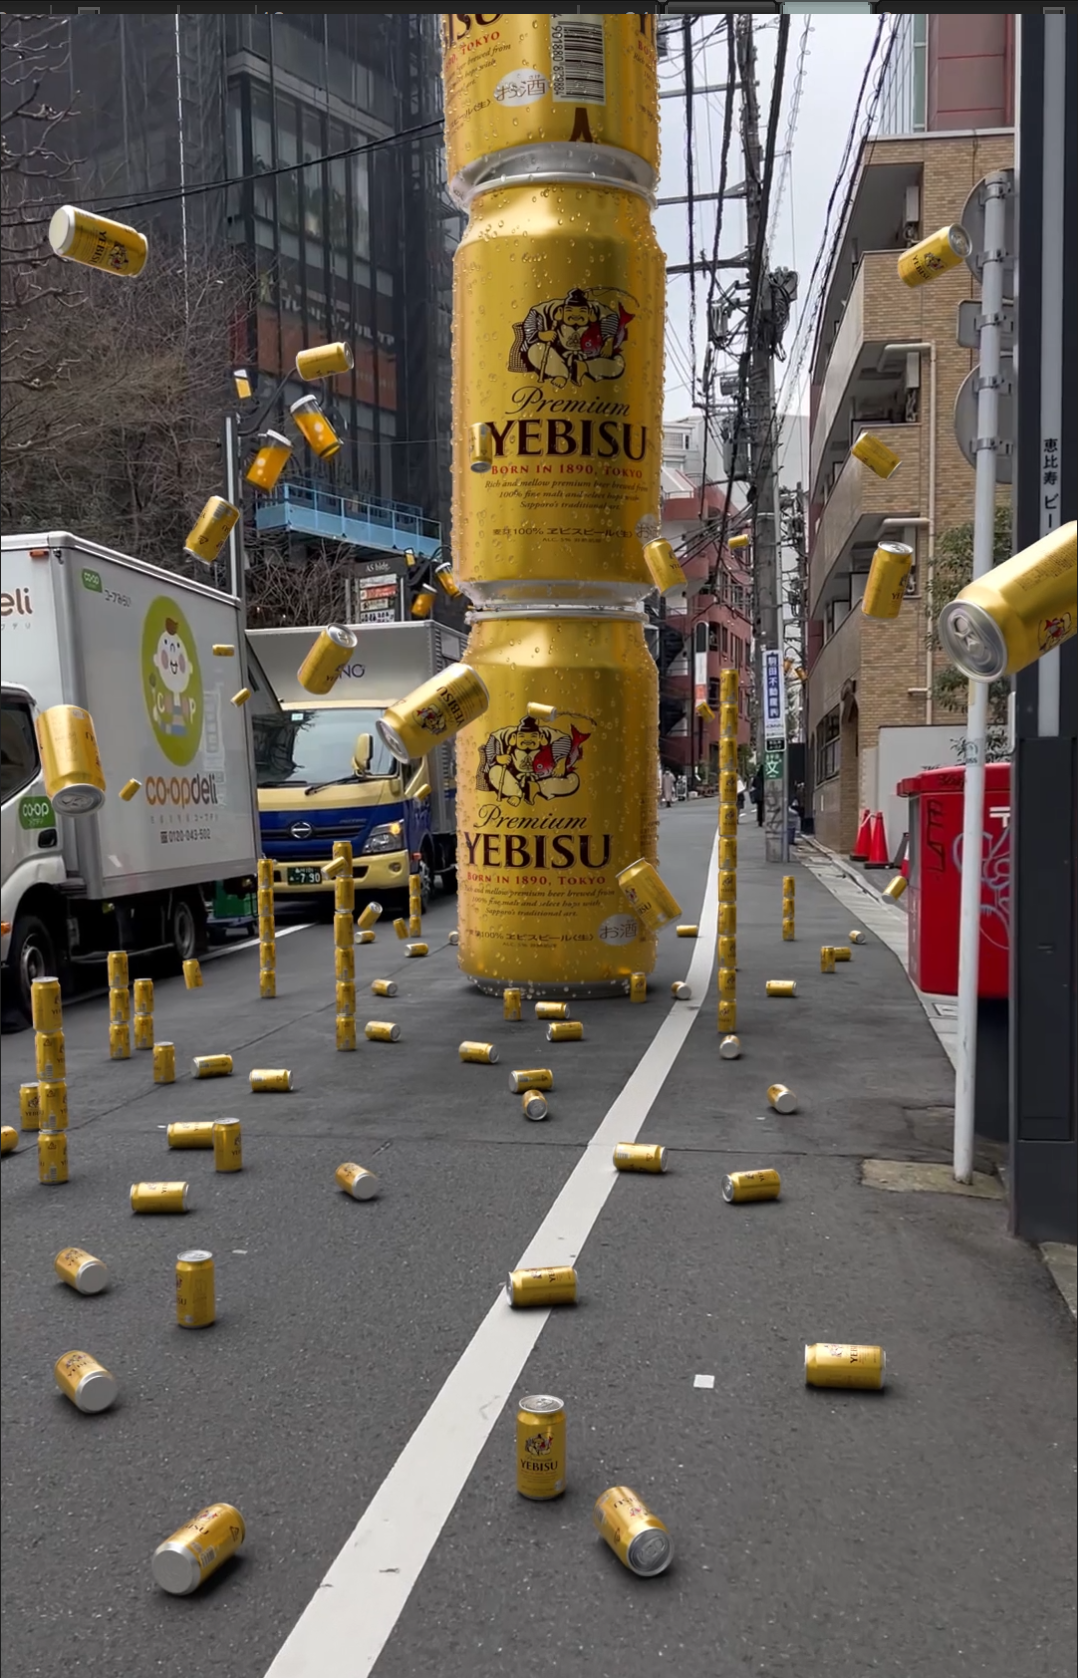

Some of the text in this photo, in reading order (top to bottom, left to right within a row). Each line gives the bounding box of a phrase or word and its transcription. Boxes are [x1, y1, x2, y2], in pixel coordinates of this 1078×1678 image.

[461, 31, 500, 55] TOKYO
[495, 79, 546, 101] お酒
[505, 386, 630, 417] Premium
[484, 419, 647, 461] YEBISU
[491, 464, 642, 478] BORN IN 1890, TOKYO
[485, 480, 501, 488] Rich
[520, 478, 550, 487] mellow
[551, 480, 591, 488] premium
[612, 481, 635, 490] brewed
[635, 483, 648, 493] from
[1043, 438, 1059, 535] 恵比寿 ビー
[499, 489, 522, 498] 100%
[524, 490, 540, 499] fine
[607, 492, 623, 501] hops
[520, 501, 559, 510] Sapporo's
[436, 686, 465, 727] YEBISU
[473, 804, 588, 830] Premium
[463, 831, 613, 869] YEBISU
[467, 872, 606, 886] BORN IN 1890, TOKYO
[485, 887, 506, 895] mellow
[508, 890, 545, 898] premium
[567, 889, 597, 897] brewed
[595, 889, 615, 898] from
[562, 900, 580, 908] hops
[486, 908, 516, 916] Sapporo's
[599, 923, 637, 939] お酒
[520, 1459, 558, 1471] YEBISU
